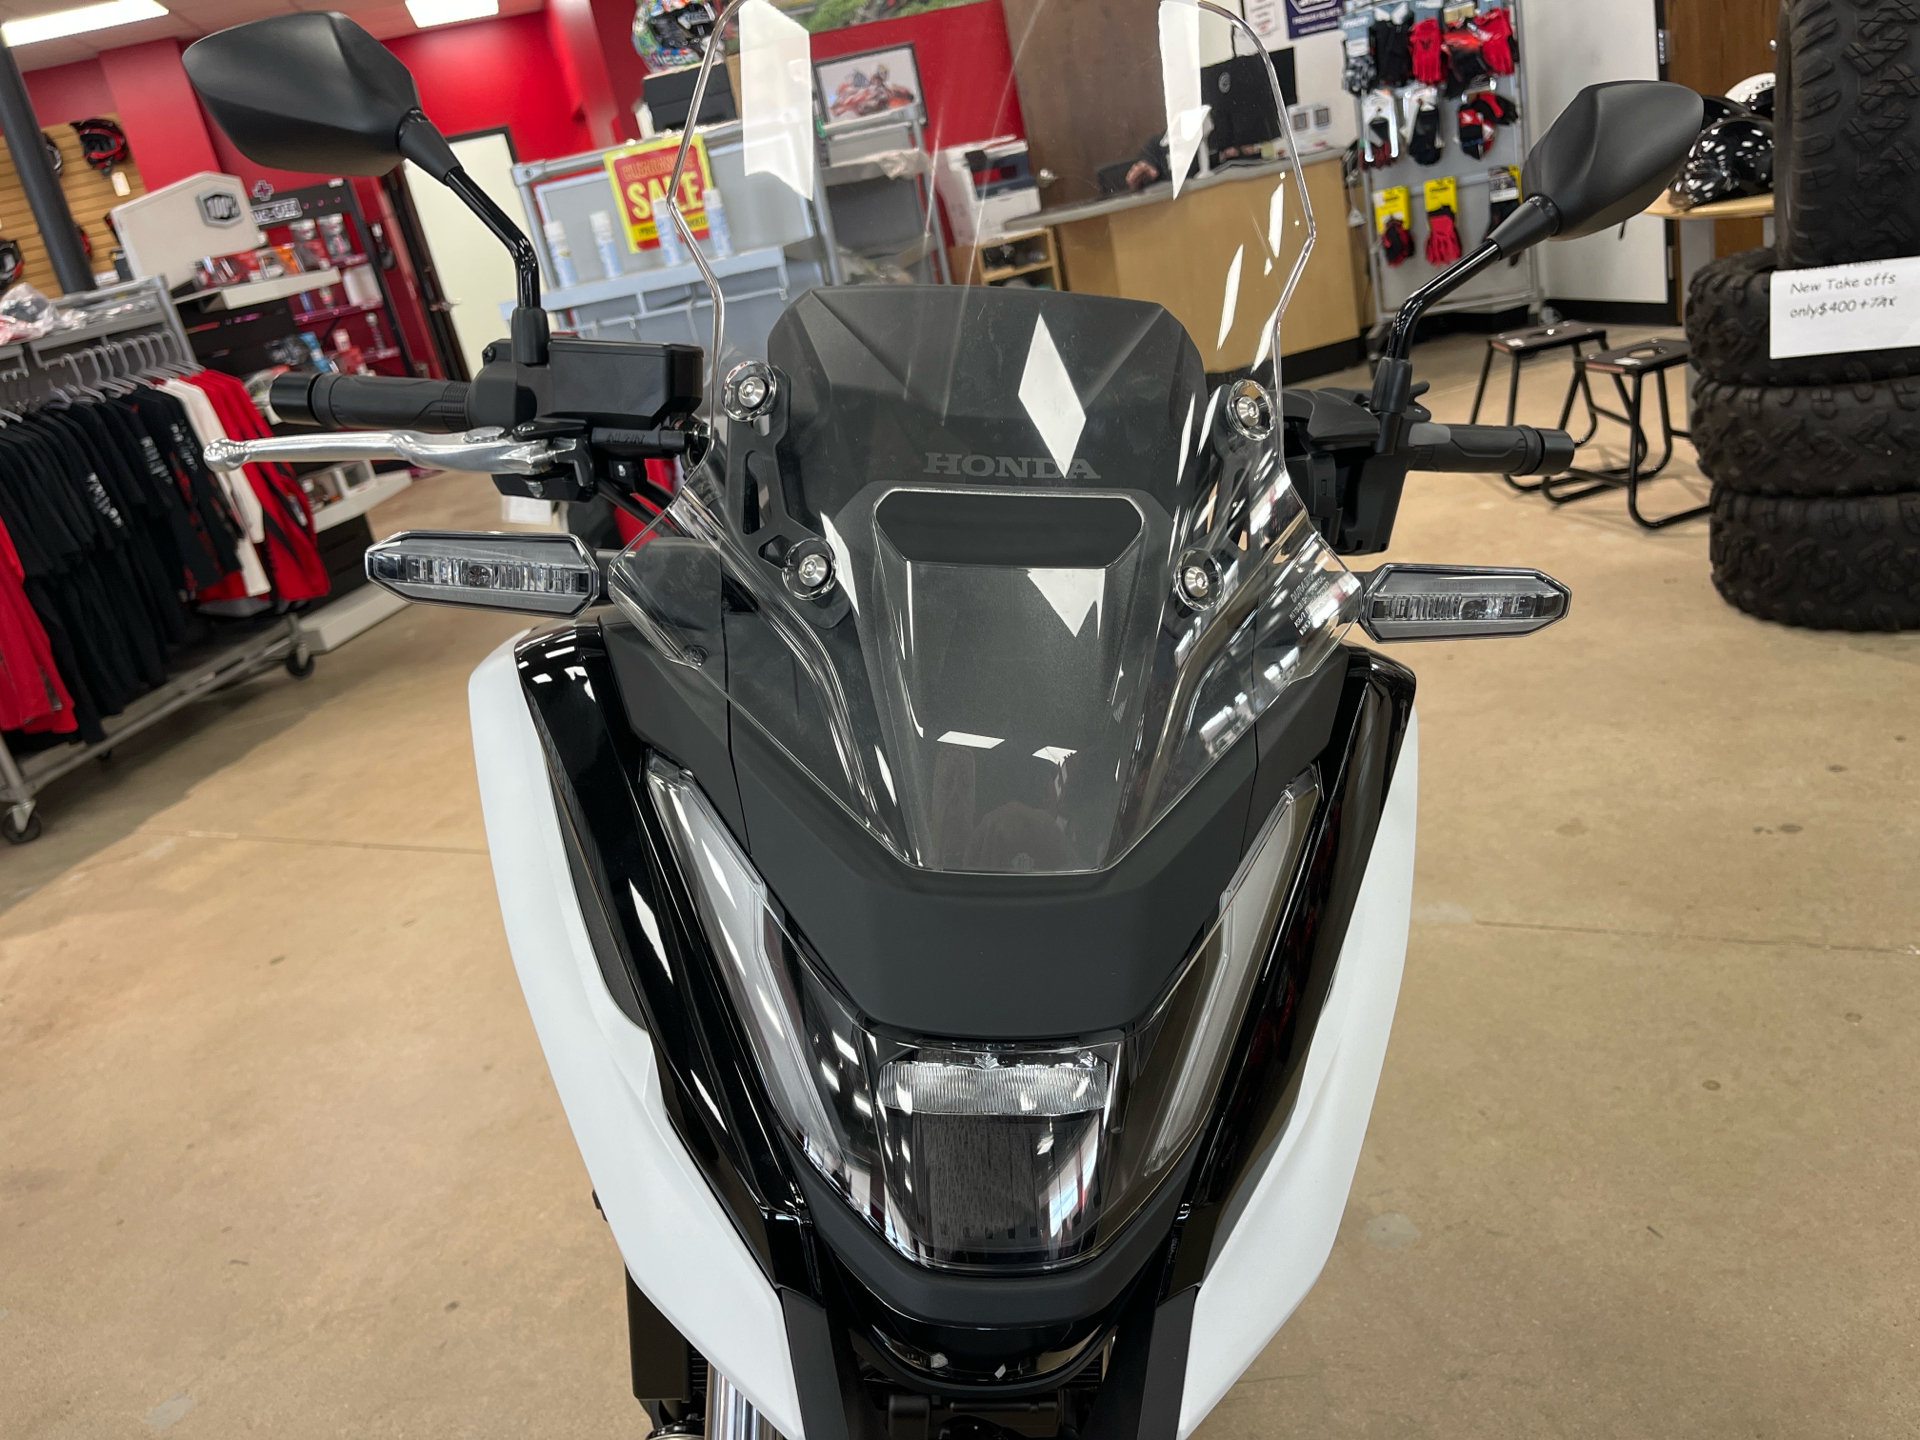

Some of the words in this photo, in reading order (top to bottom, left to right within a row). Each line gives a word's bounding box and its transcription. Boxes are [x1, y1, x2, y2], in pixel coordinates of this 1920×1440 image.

[1790, 282, 1821, 294] New
[1827, 278, 1860, 290] Take
[1864, 272, 1896, 287] offs
[922, 452, 1101, 479] HONDA
